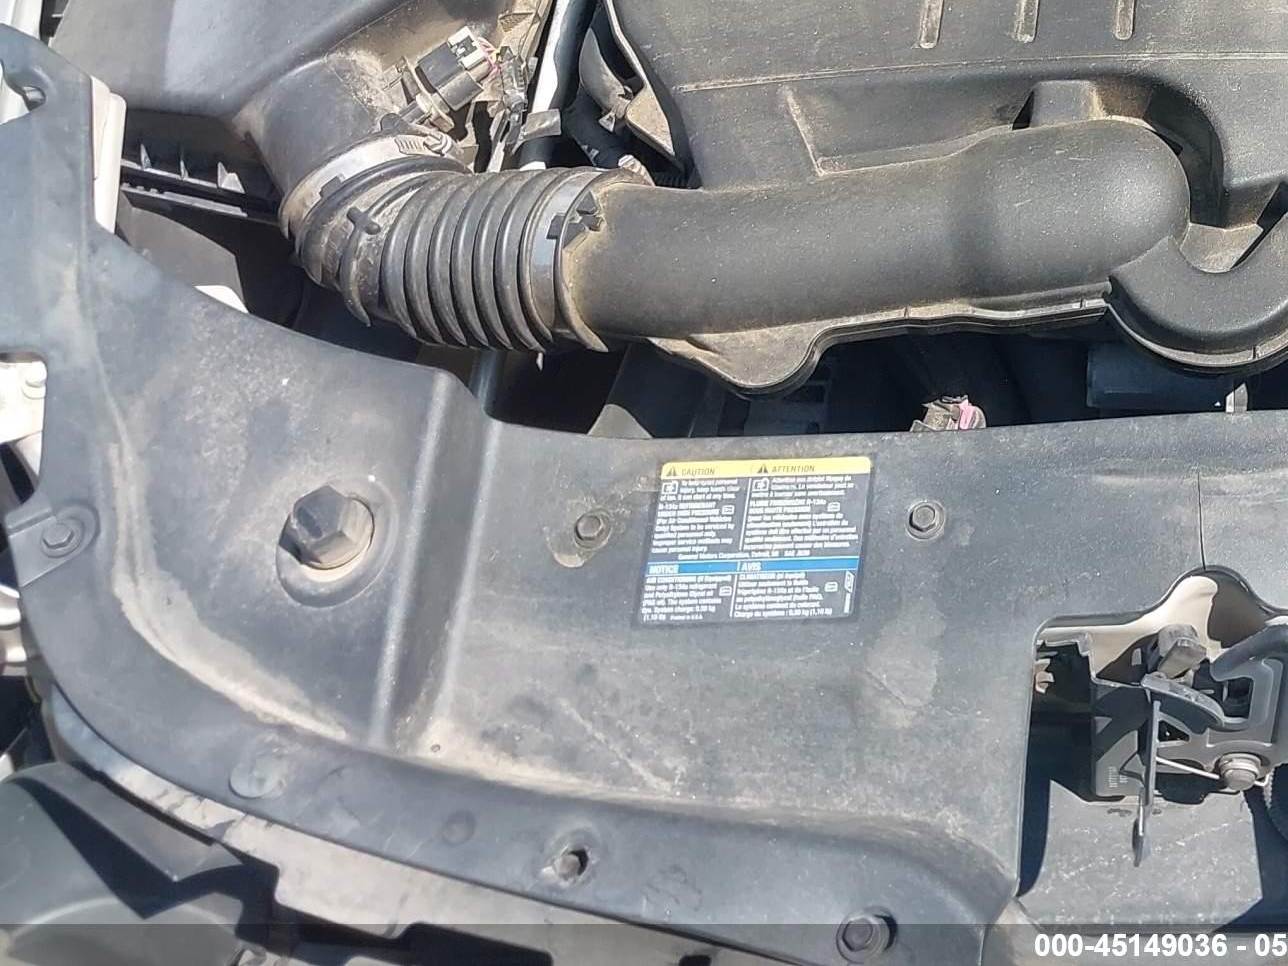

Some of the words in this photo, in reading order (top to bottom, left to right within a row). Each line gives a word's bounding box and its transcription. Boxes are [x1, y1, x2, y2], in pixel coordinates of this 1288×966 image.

[681, 468, 715, 476] CAUTION
[771, 465, 815, 474] ATTENTION
[649, 564, 679, 574] NOTICE
[741, 562, 762, 571] AVIS
